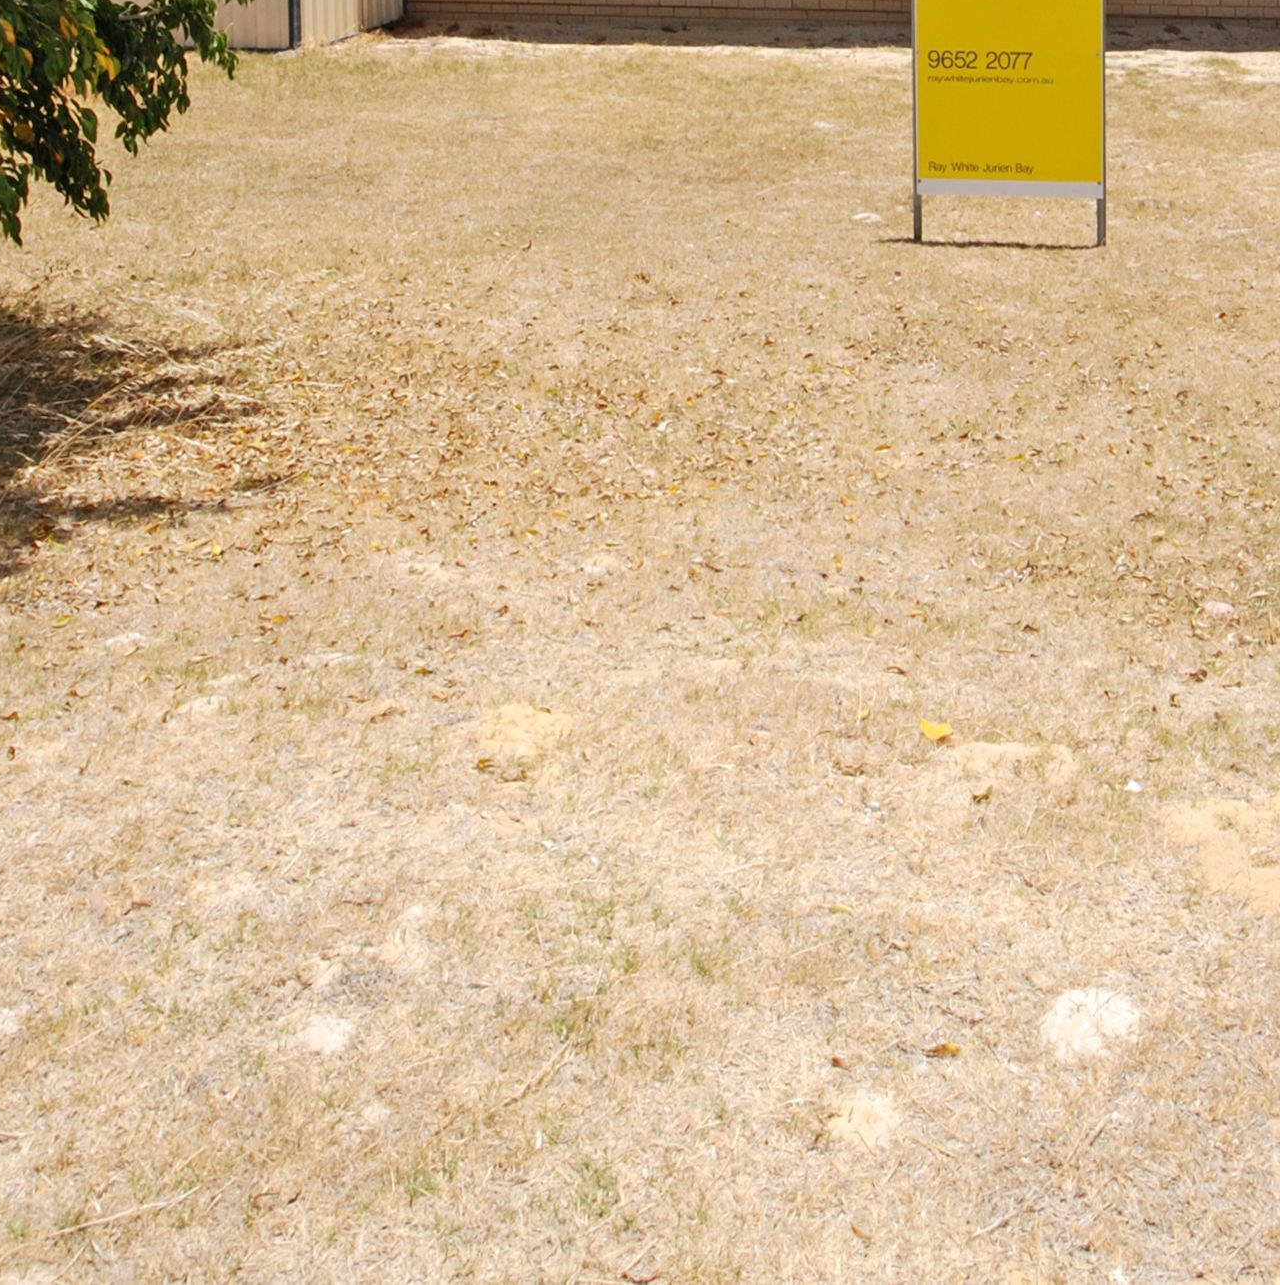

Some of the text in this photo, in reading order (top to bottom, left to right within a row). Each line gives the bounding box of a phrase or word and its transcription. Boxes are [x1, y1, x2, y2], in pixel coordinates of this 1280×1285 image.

[927, 50, 1033, 70] 9652 2077
[928, 161, 947, 173] Ray
[951, 162, 979, 172] White
[1015, 163, 1034, 175] Bay
